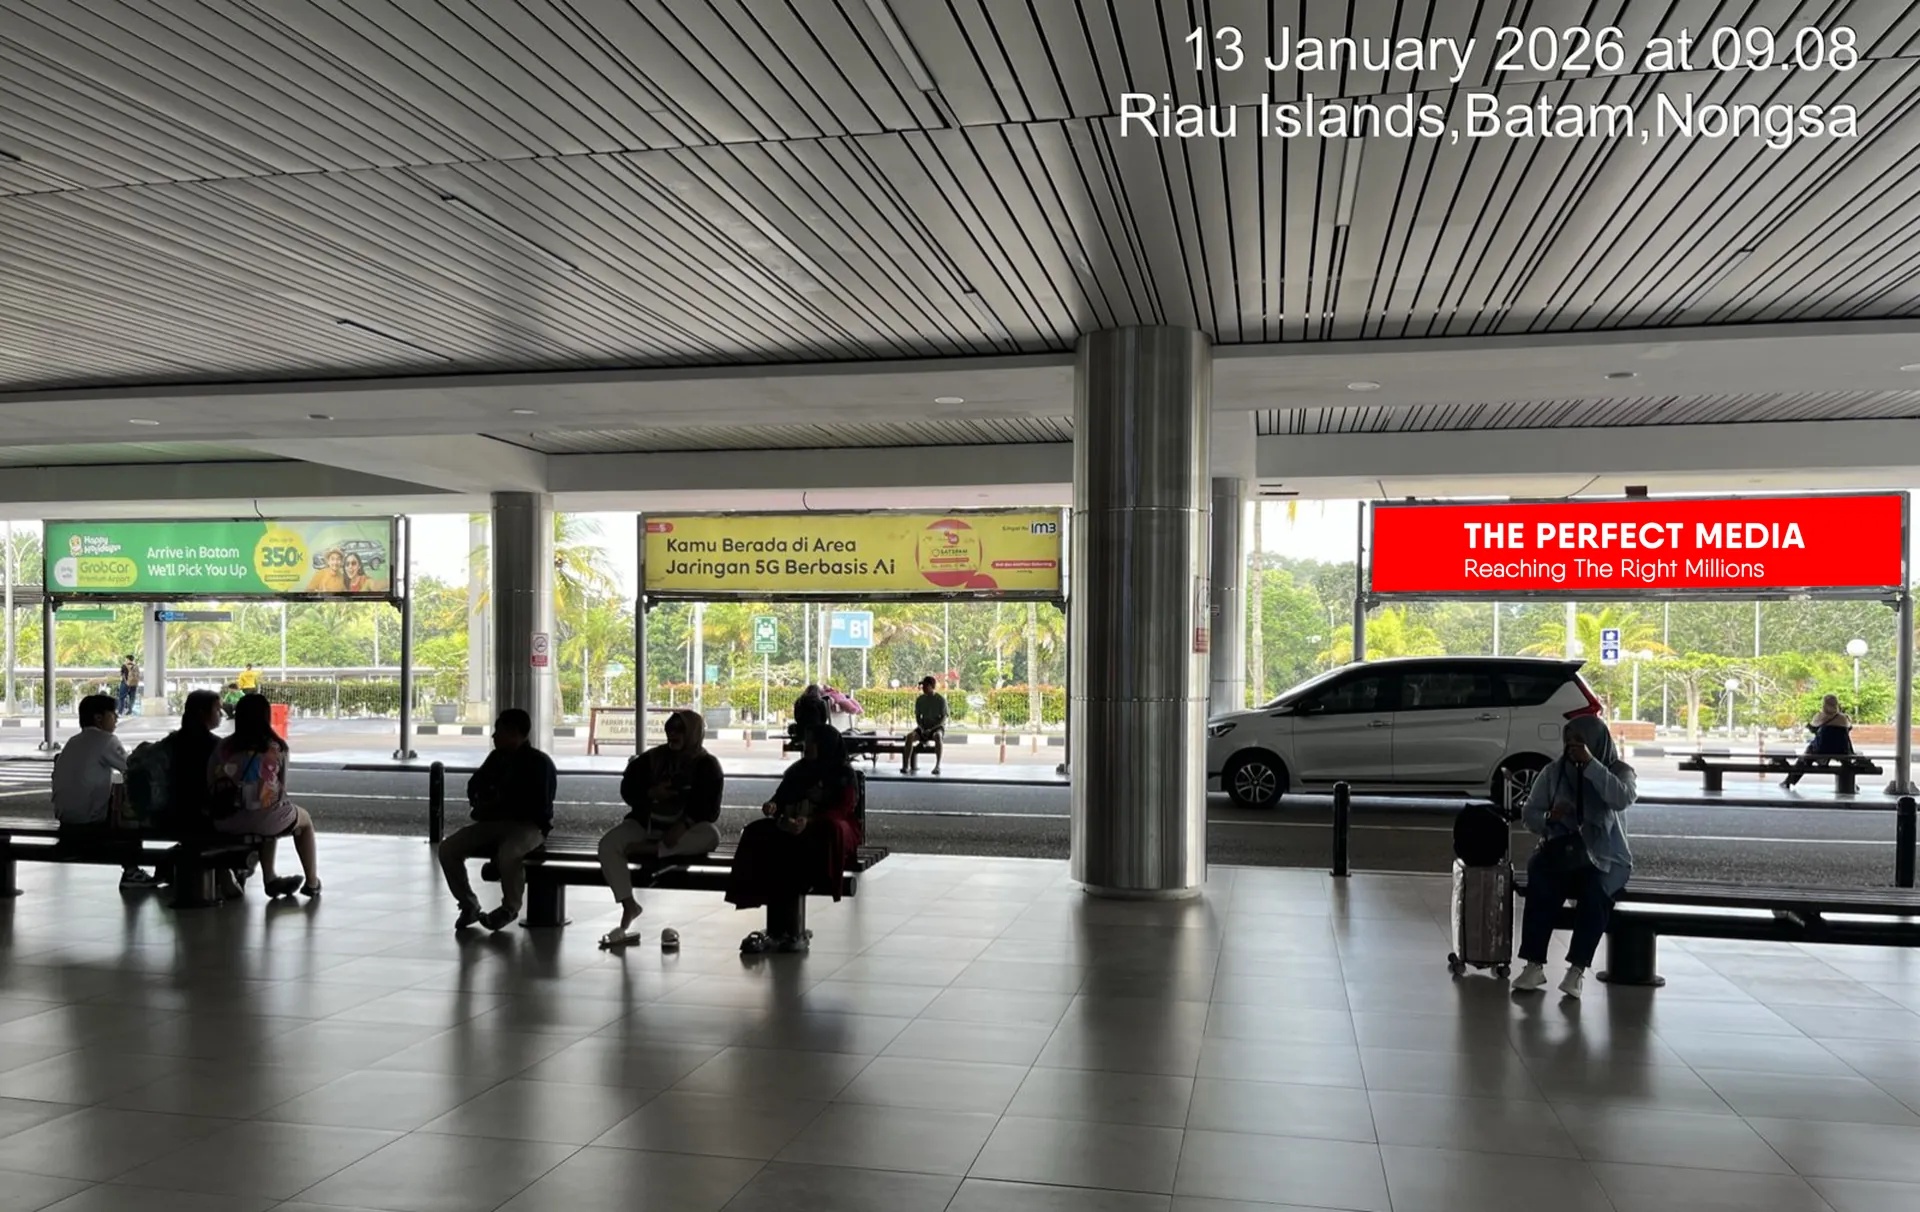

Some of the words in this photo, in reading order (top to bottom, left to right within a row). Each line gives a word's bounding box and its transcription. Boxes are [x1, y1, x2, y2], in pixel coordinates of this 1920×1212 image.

[666, 538, 717, 552] Kamu
[722, 537, 788, 553] Berada
[792, 537, 809, 552] di
[813, 537, 856, 552] Area
[1464, 522, 1525, 549] THE
[1536, 521, 1684, 550] PERFECT
[1696, 522, 1806, 549] MEDIA
[147, 546, 184, 560] Arrive
[186, 546, 197, 559] in
[199, 546, 240, 559] Batam
[147, 563, 176, 577] We'll
[178, 563, 203, 577] Pick
[205, 563, 228, 577] You
[230, 563, 248, 579] Up
[666, 558, 750, 579] Jaringan
[755, 559, 780, 575] 5G
[785, 559, 868, 575] Berbasis
[1464, 558, 1567, 583] Reaching
[1574, 558, 1614, 578] The
[1621, 558, 1678, 583] Right
[1686, 558, 1765, 578] Millions
[849, 619, 869, 639] B1
